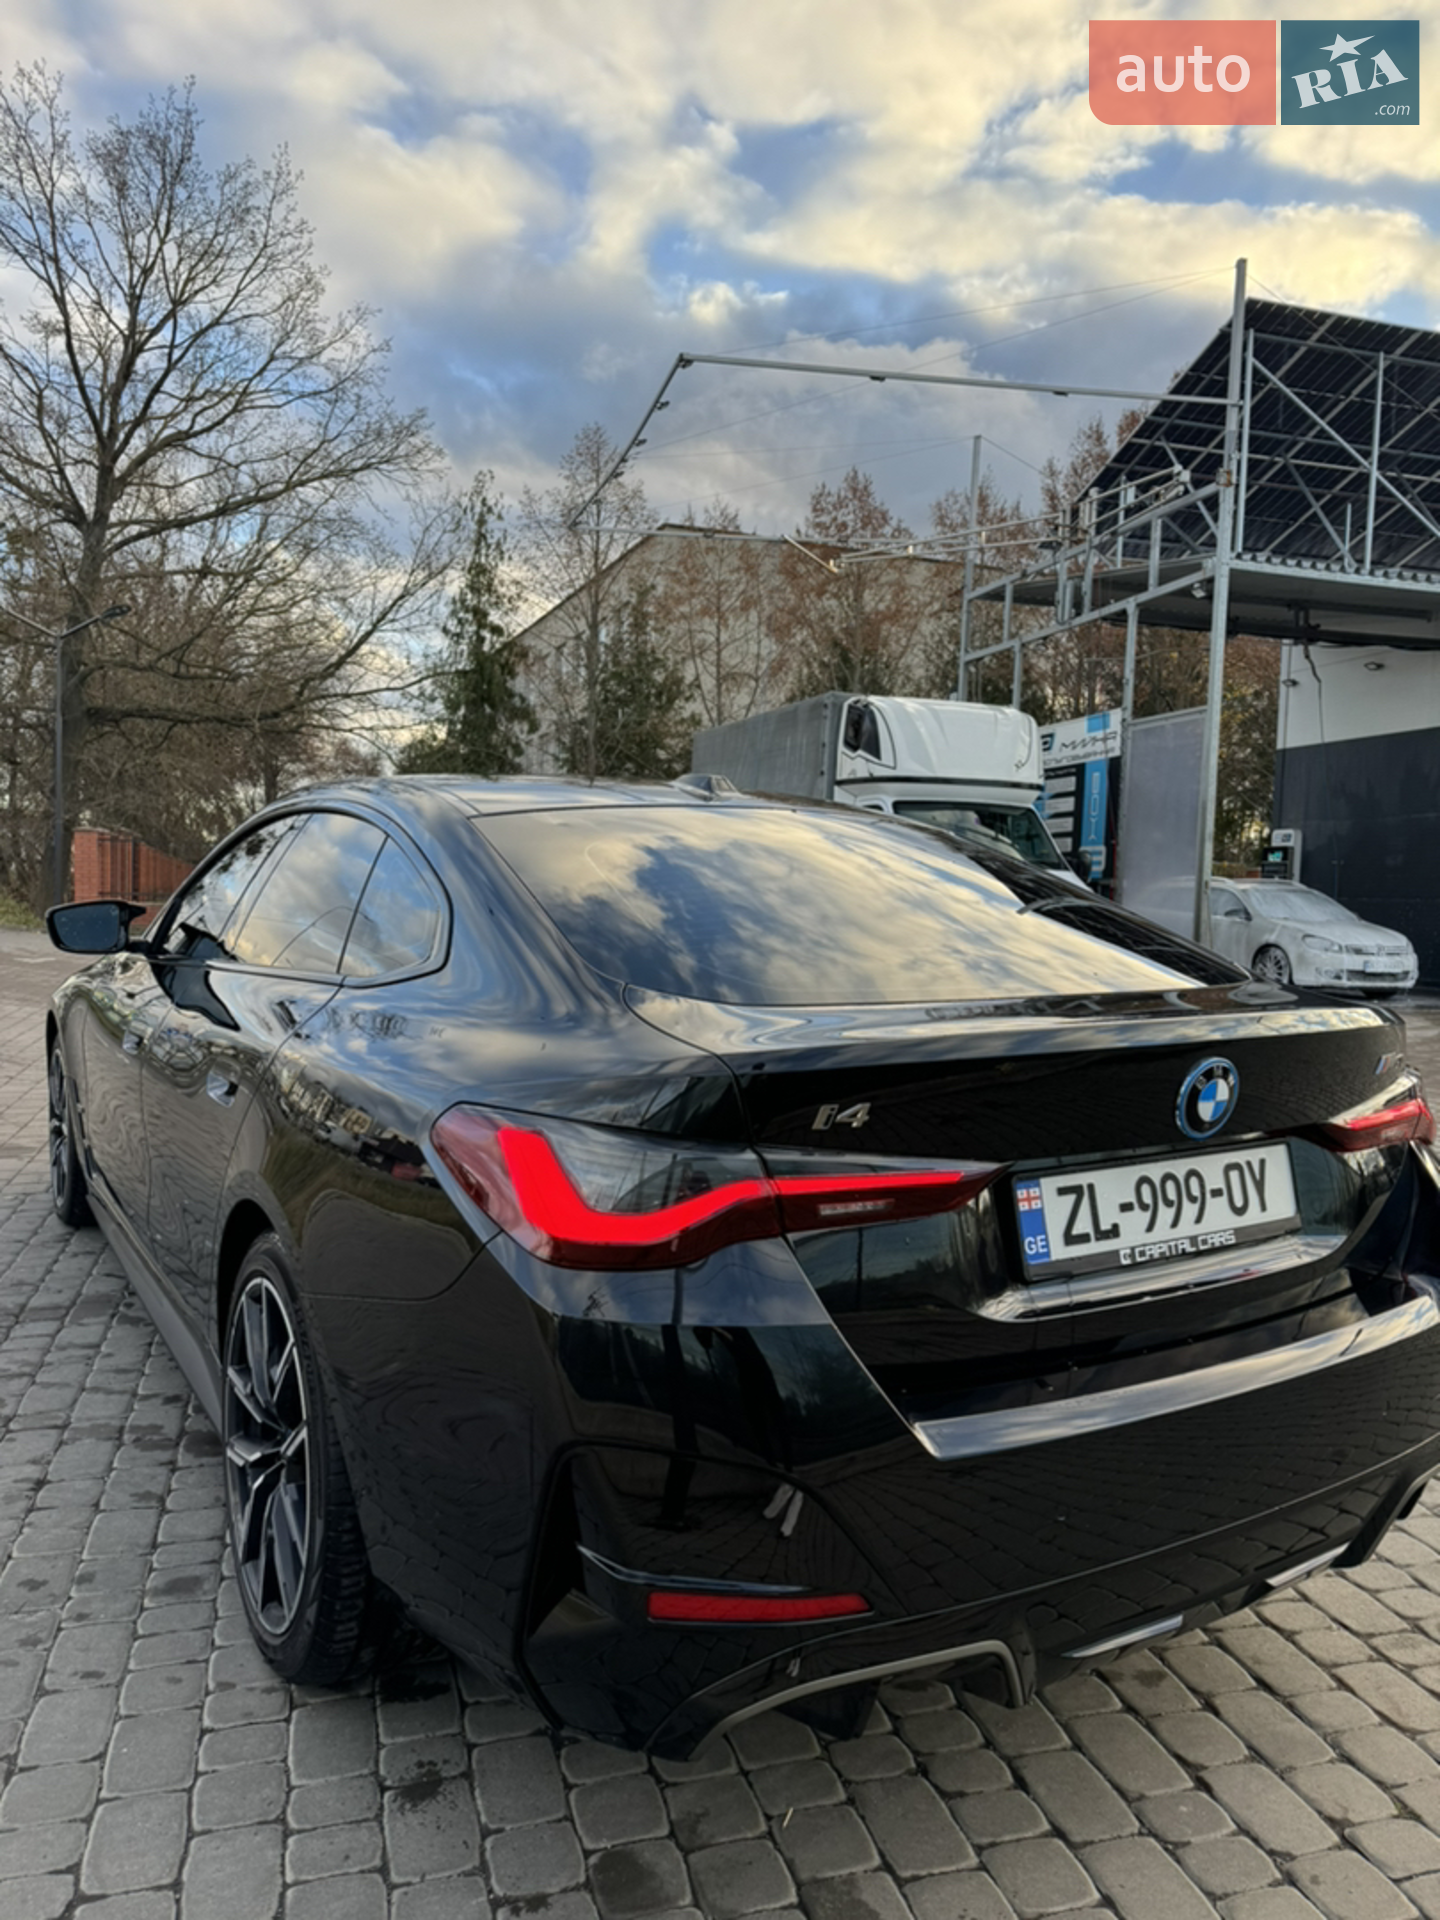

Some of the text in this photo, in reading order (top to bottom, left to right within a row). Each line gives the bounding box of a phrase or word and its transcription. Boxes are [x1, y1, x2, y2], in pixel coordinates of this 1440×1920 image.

[811, 1102, 871, 1130] i4
[1056, 1157, 1267, 1247] ZL-999-OY
[1024, 1234, 1048, 1256] GE
[1134, 1229, 1236, 1262] CAPITAL CARS
